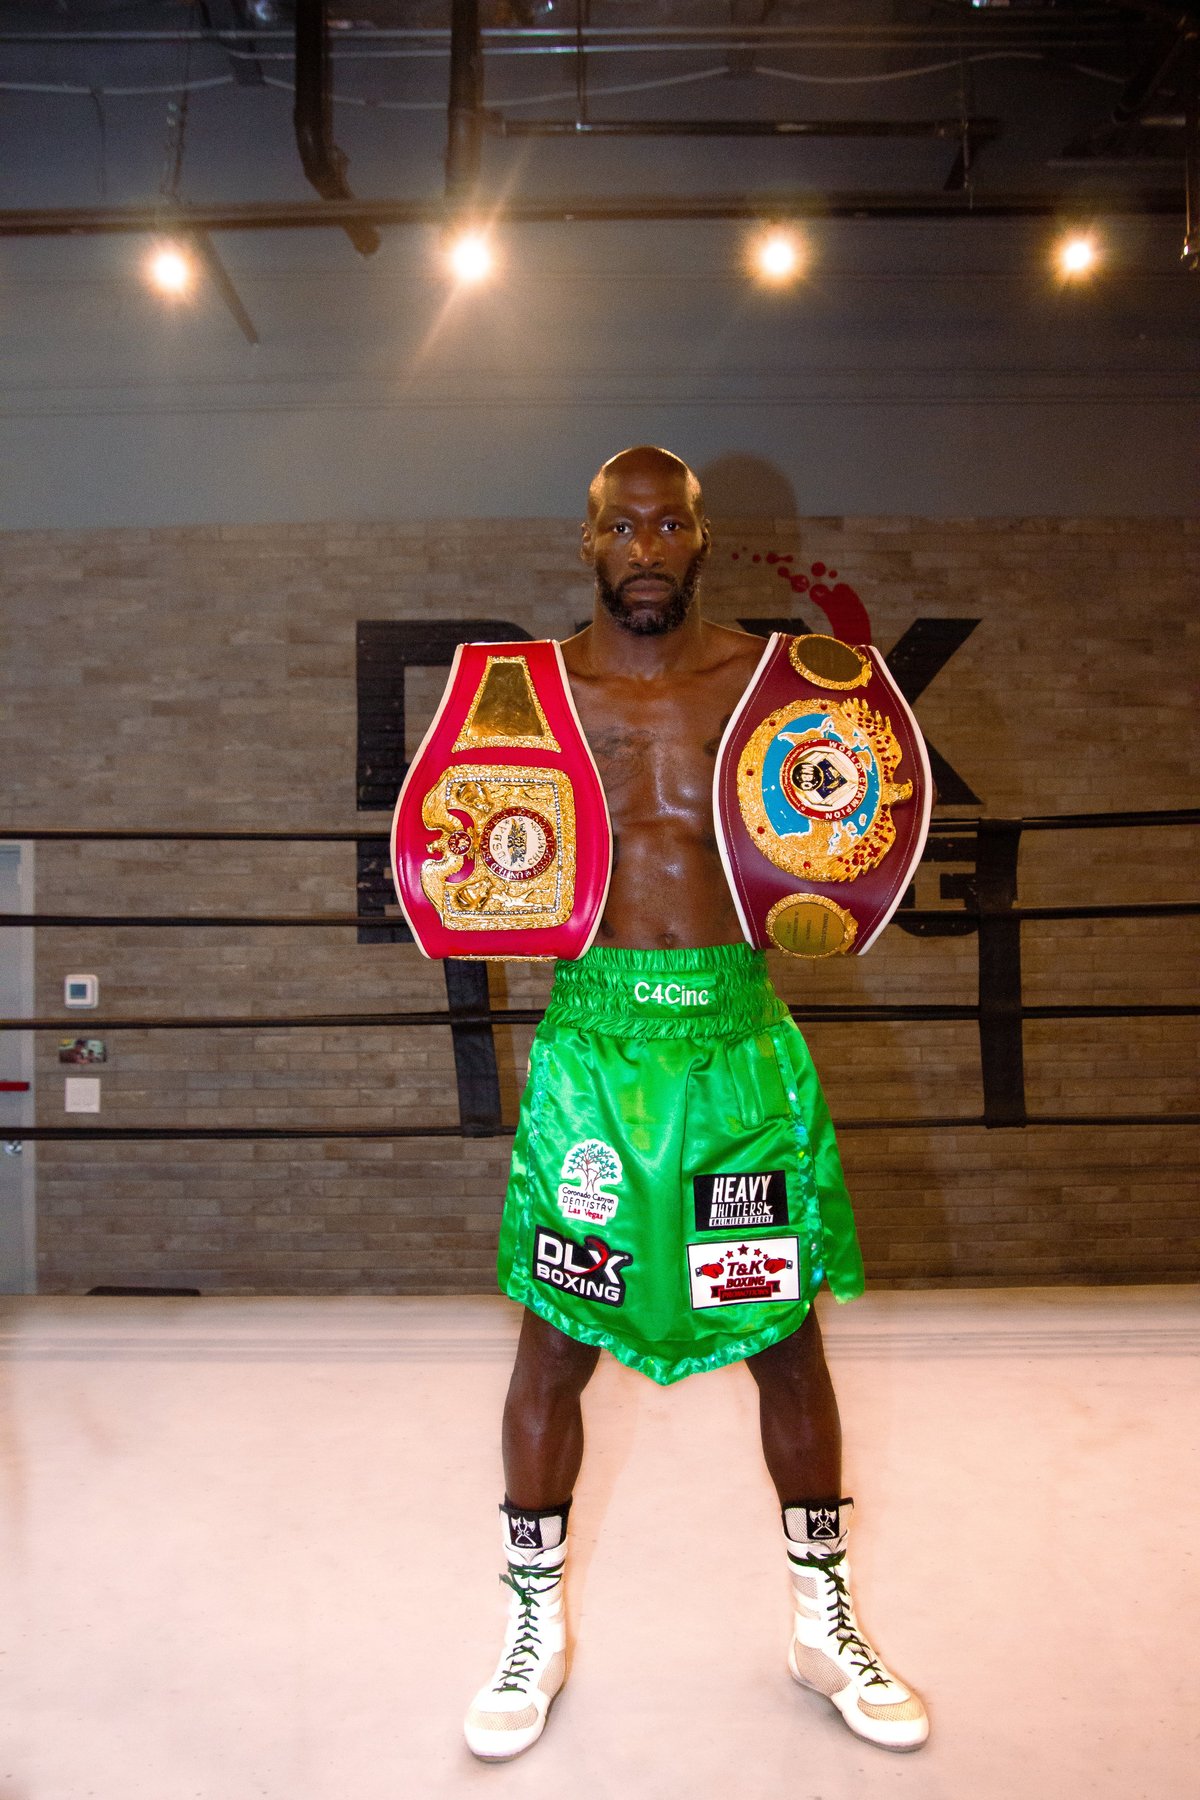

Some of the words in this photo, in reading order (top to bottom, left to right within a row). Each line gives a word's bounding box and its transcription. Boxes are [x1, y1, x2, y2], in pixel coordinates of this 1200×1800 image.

[828, 740, 863, 769] WORLD
[801, 763, 815, 790] WBO
[825, 777, 867, 820] CHAMPION
[634, 981, 709, 1006] C4Cinc
[562, 1187, 591, 1199] Coronado
[592, 1193, 614, 1204] Canyon
[712, 1175, 772, 1203] HEAVY
[562, 1195, 613, 1212] DENTISTRY
[717, 1201, 763, 1218] HITTERS
[568, 1205, 581, 1214] Las
[584, 1208, 603, 1220] Vegas
[710, 1217, 746, 1226] UNLIMITED
[538, 1234, 624, 1284] DLX
[727, 1260, 763, 1277] T&K
[537, 1263, 620, 1302] BOXING
[726, 1275, 765, 1288] BOXING
[722, 1288, 769, 1299] PROMOTIONS
